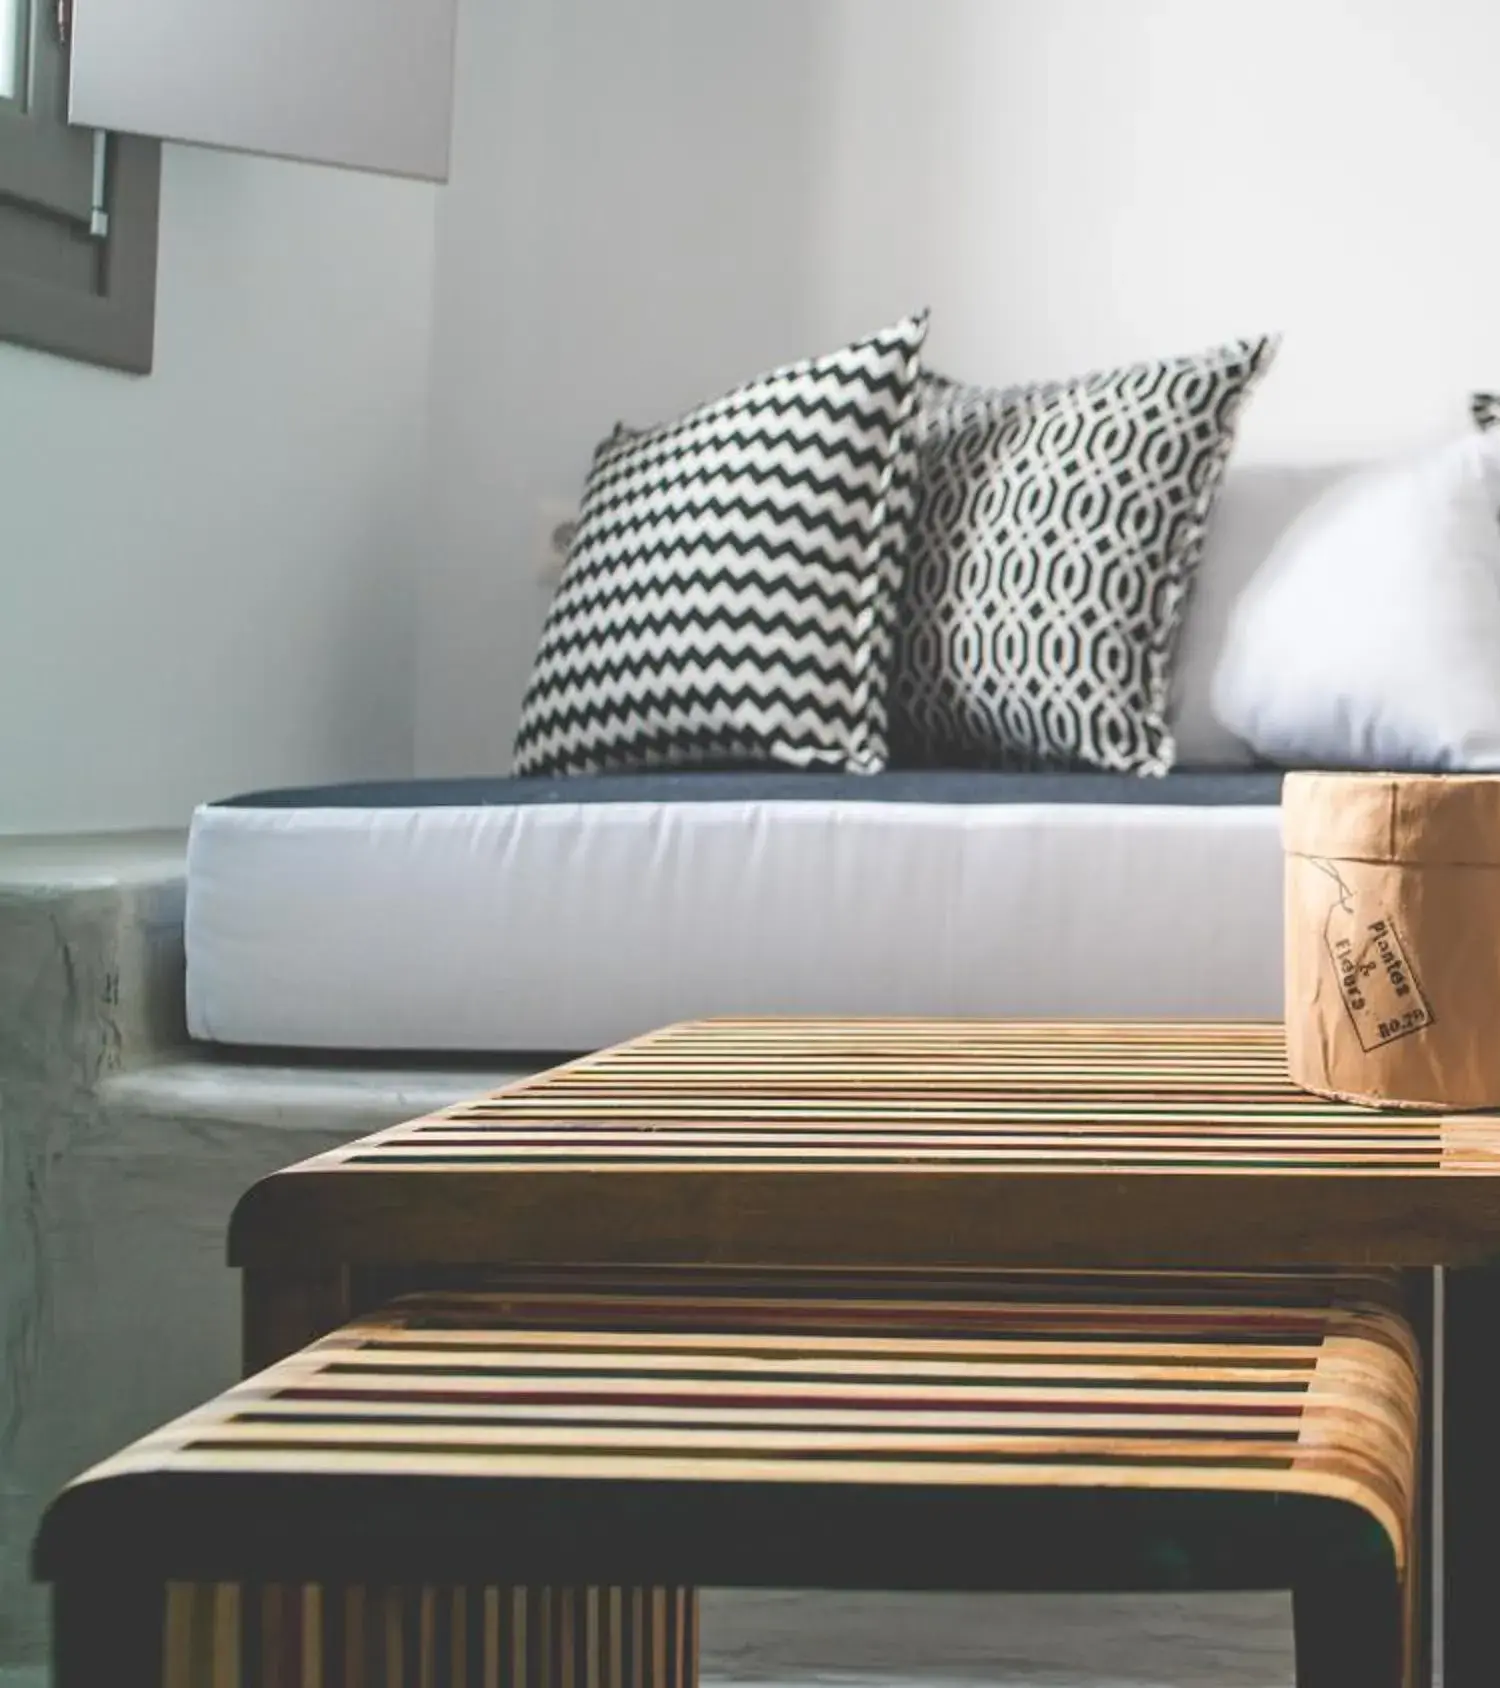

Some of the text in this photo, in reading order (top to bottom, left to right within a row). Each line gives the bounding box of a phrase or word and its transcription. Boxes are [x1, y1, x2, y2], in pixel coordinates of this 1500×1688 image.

[1335, 938, 1366, 1011] Fleurs
[1359, 961, 1377, 977] &
[1368, 920, 1411, 998] Plantes
